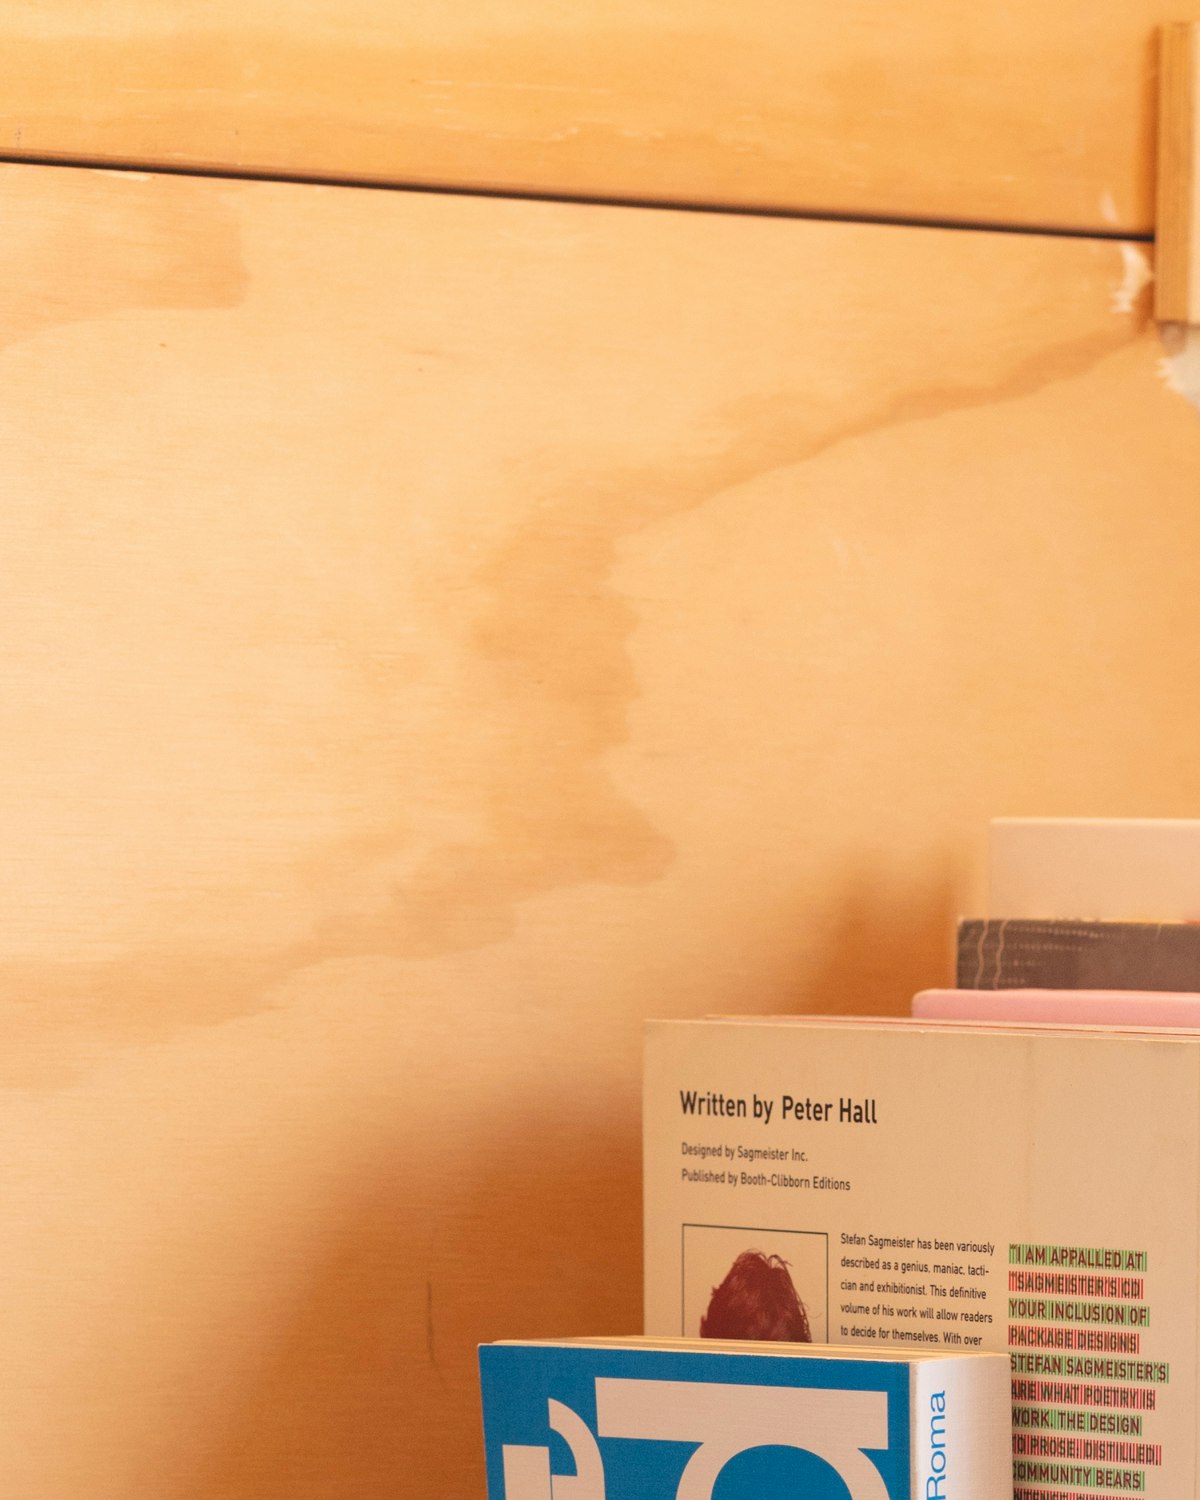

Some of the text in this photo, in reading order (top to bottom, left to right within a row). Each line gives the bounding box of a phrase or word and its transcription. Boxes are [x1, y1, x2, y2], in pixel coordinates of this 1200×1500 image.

[680, 1091, 877, 1124] Written by Peter Hall
[681, 1142, 809, 1162] Designed by Sagmeister Inc.
[681, 1168, 851, 1191] Published by Booth-Clibborn Editions
[841, 1233, 995, 1256] Stefan Sagmeister has been variously
[841, 1256, 989, 1276] described as a genius, maniac, tacti-
[1025, 1247, 1143, 1270] AM APPALLED AT
[841, 1279, 987, 1300] cian and exhibitionist. This definitive
[1121, 1280, 1141, 1298] CD
[840, 1302, 993, 1324] volume of his work will allow readers
[1009, 1299, 1147, 1326] YOUR INCLUSION OF
[841, 1325, 983, 1346] to decide for themselves. With over
[1010, 1326, 1137, 1353] PACKAGE DESIGNS
[1010, 1354, 1167, 1382] STEFAN SAGMEISTER'S
[1011, 1381, 1154, 1409] ARE WHAT POETRY IS
[1057, 1411, 1141, 1434] THE DESIGN
[1096, 1470, 1142, 1490] BEARS
